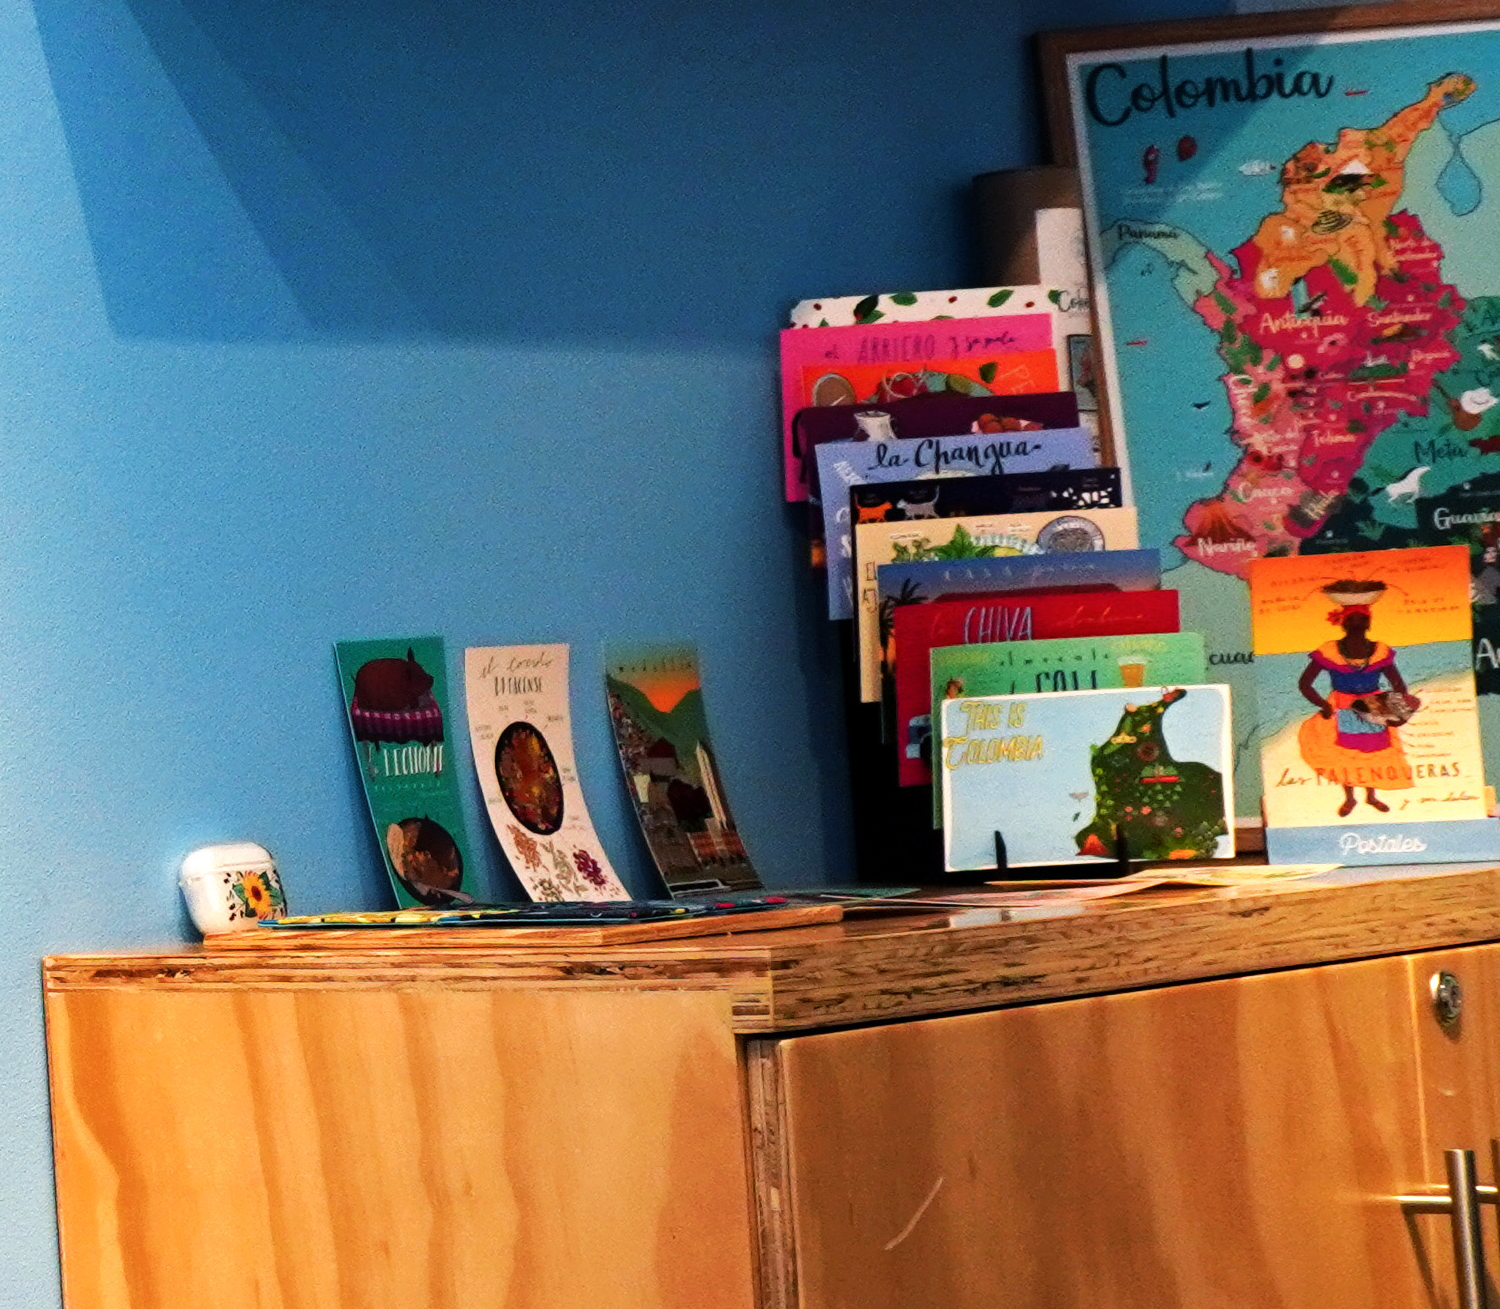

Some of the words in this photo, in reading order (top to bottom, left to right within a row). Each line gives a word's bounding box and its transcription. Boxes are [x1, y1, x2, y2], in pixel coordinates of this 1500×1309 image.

[1085, 47, 1334, 126] Colombia
[959, 700, 1001, 731] THIS
[1314, 761, 1461, 787] PALENQUERAS
[1337, 831, 1429, 856] Postales
